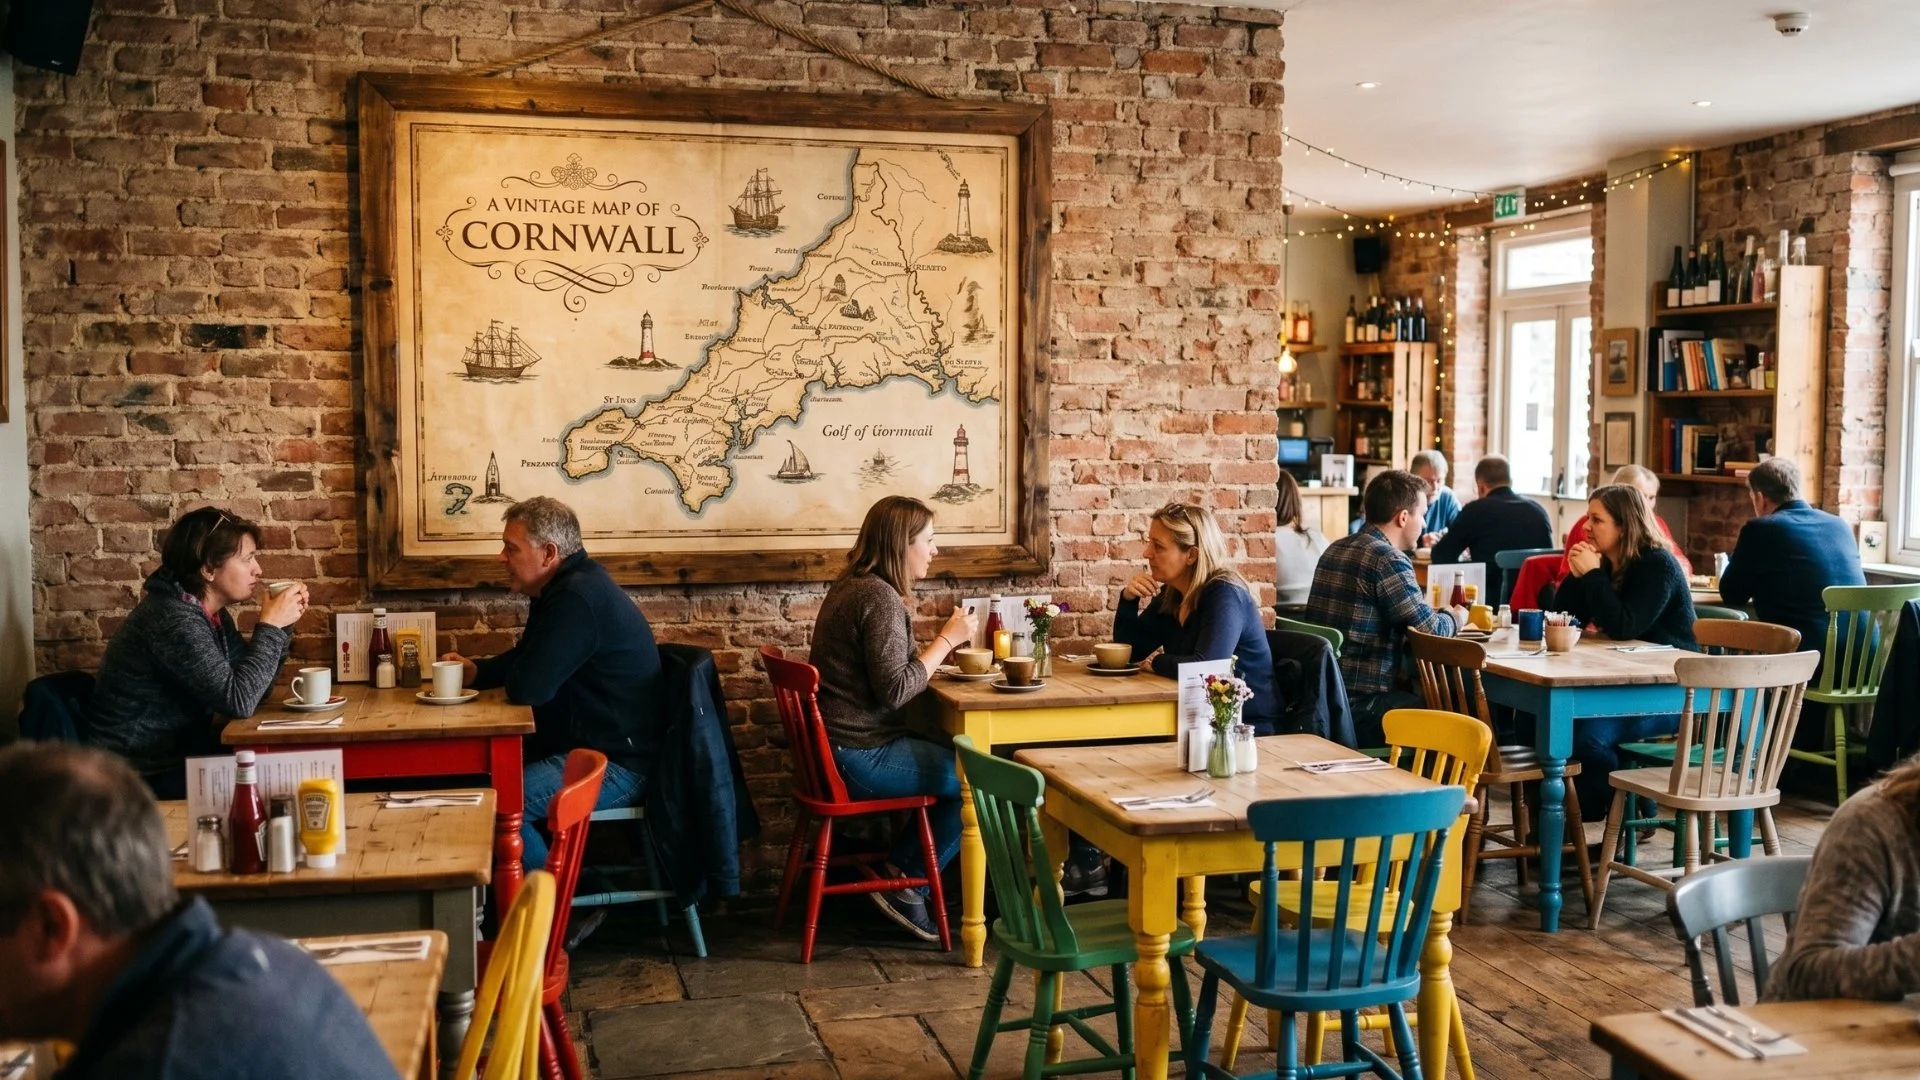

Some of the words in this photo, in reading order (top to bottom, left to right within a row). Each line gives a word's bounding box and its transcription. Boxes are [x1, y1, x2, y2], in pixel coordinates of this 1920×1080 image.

[487, 197, 499, 212] A
[504, 198, 585, 214] VINTAGE
[592, 201, 630, 216] MAP
[637, 203, 660, 216] OF
[462, 221, 685, 254] CORNWALL
[822, 424, 852, 441] Golf
[854, 424, 869, 441] of
